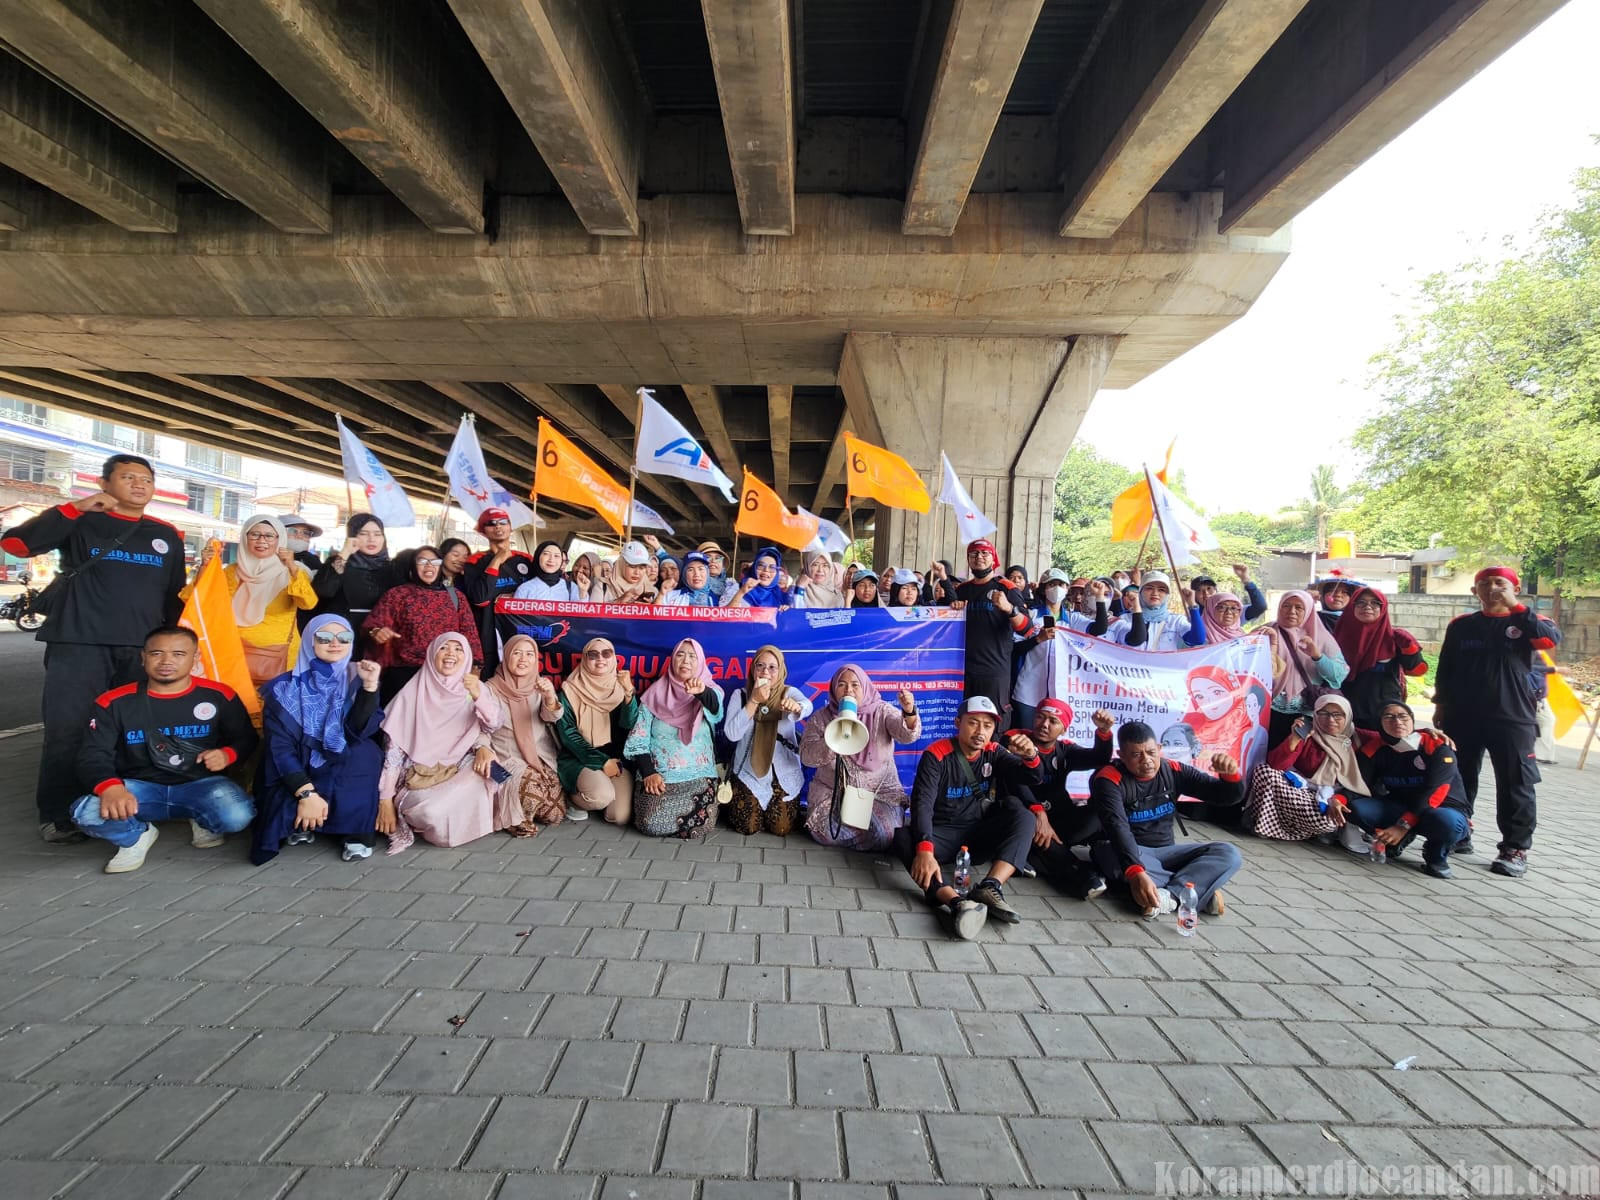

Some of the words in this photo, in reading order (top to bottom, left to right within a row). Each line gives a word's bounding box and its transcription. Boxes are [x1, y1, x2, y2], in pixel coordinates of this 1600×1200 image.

[542, 440, 558, 468] 6
[852, 452, 867, 473] 6
[745, 490, 759, 511] 6
[90, 547, 130, 560] GRDA
[504, 600, 555, 612] FEDERASI
[557, 602, 603, 614] SERIKAT
[605, 604, 650, 616] PEKERJA
[653, 606, 690, 617] METAL
[692, 607, 752, 618] INDONESIA
[1067, 677, 1109, 696] Hari
[1068, 696, 1133, 713] Perempuan
[1137, 700, 1169, 714] Metal
[1114, 713, 1145, 725] ekasi
[1068, 726, 1093, 739] Berb
